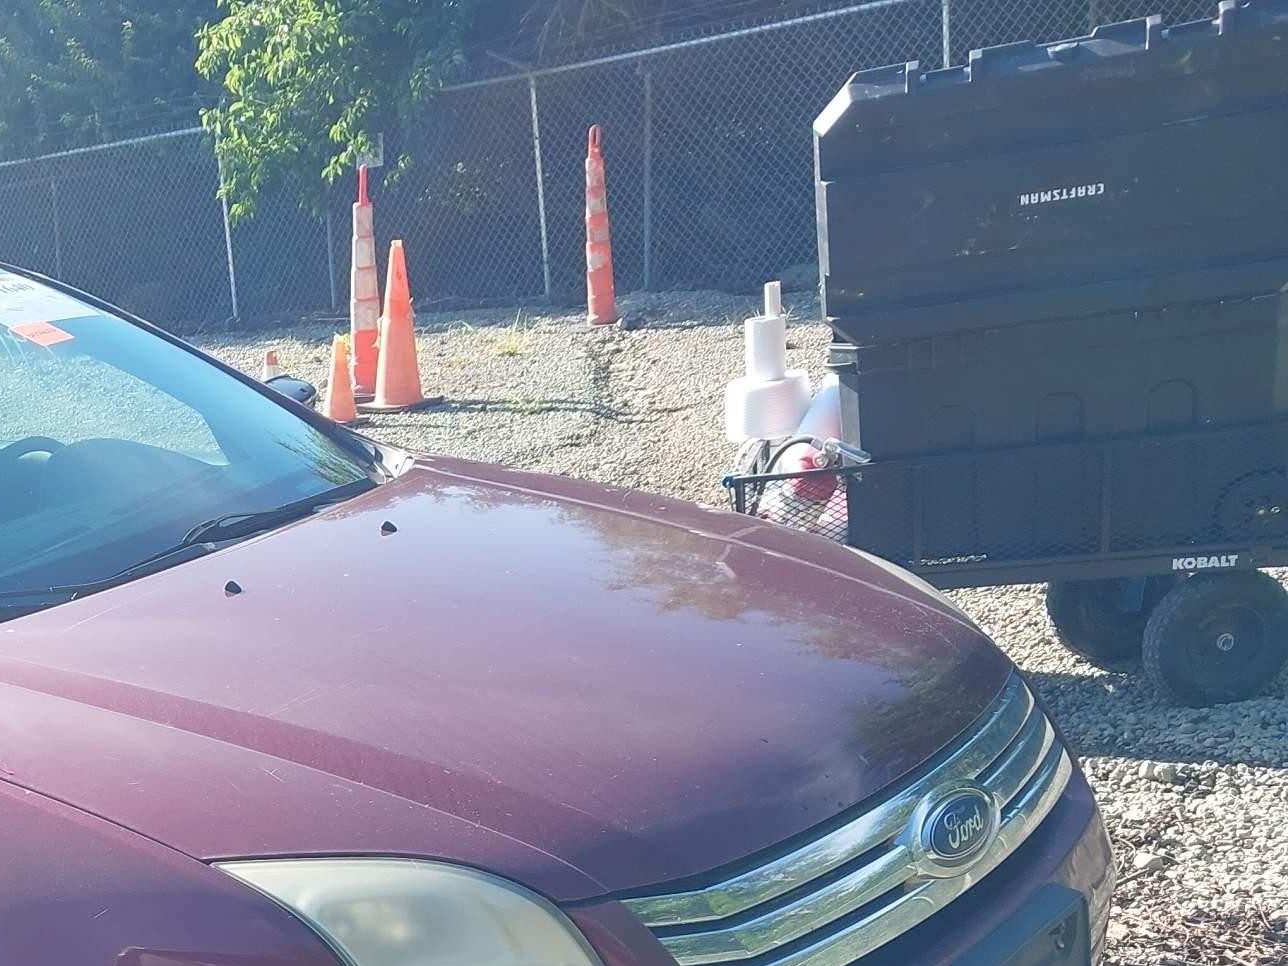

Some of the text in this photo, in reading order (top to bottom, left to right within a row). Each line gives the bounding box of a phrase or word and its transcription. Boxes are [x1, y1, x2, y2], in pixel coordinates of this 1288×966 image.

[1020, 183, 1105, 206] CRAFTSMAN
[1172, 554, 1238, 570] KOBALT
[944, 804, 984, 849] Ford
